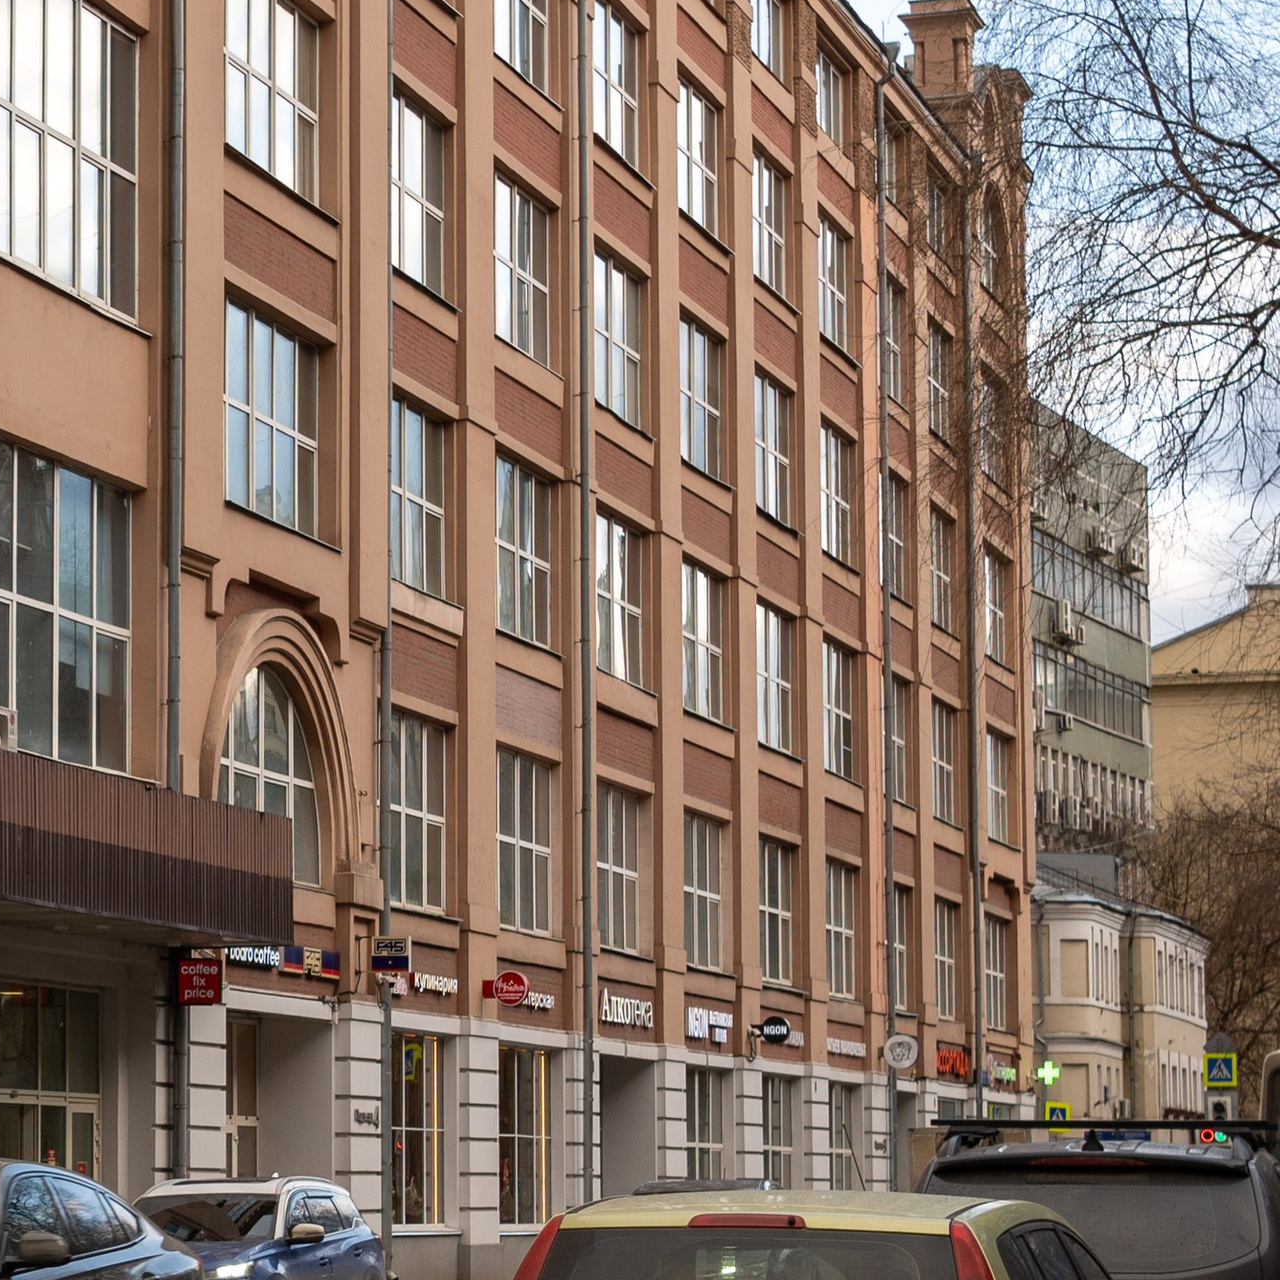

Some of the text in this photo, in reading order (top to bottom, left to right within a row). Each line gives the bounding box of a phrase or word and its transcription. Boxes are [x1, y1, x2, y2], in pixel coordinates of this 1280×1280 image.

[375, 938, 406, 955] F45
[253, 945, 280, 966] coffee
[180, 964, 219, 975] coffee
[192, 976, 206, 987] fix
[414, 971, 459, 996] кулинария
[184, 987, 215, 1001] price
[688, 1006, 709, 1039] NGON
[763, 1025, 788, 1035] NGON
